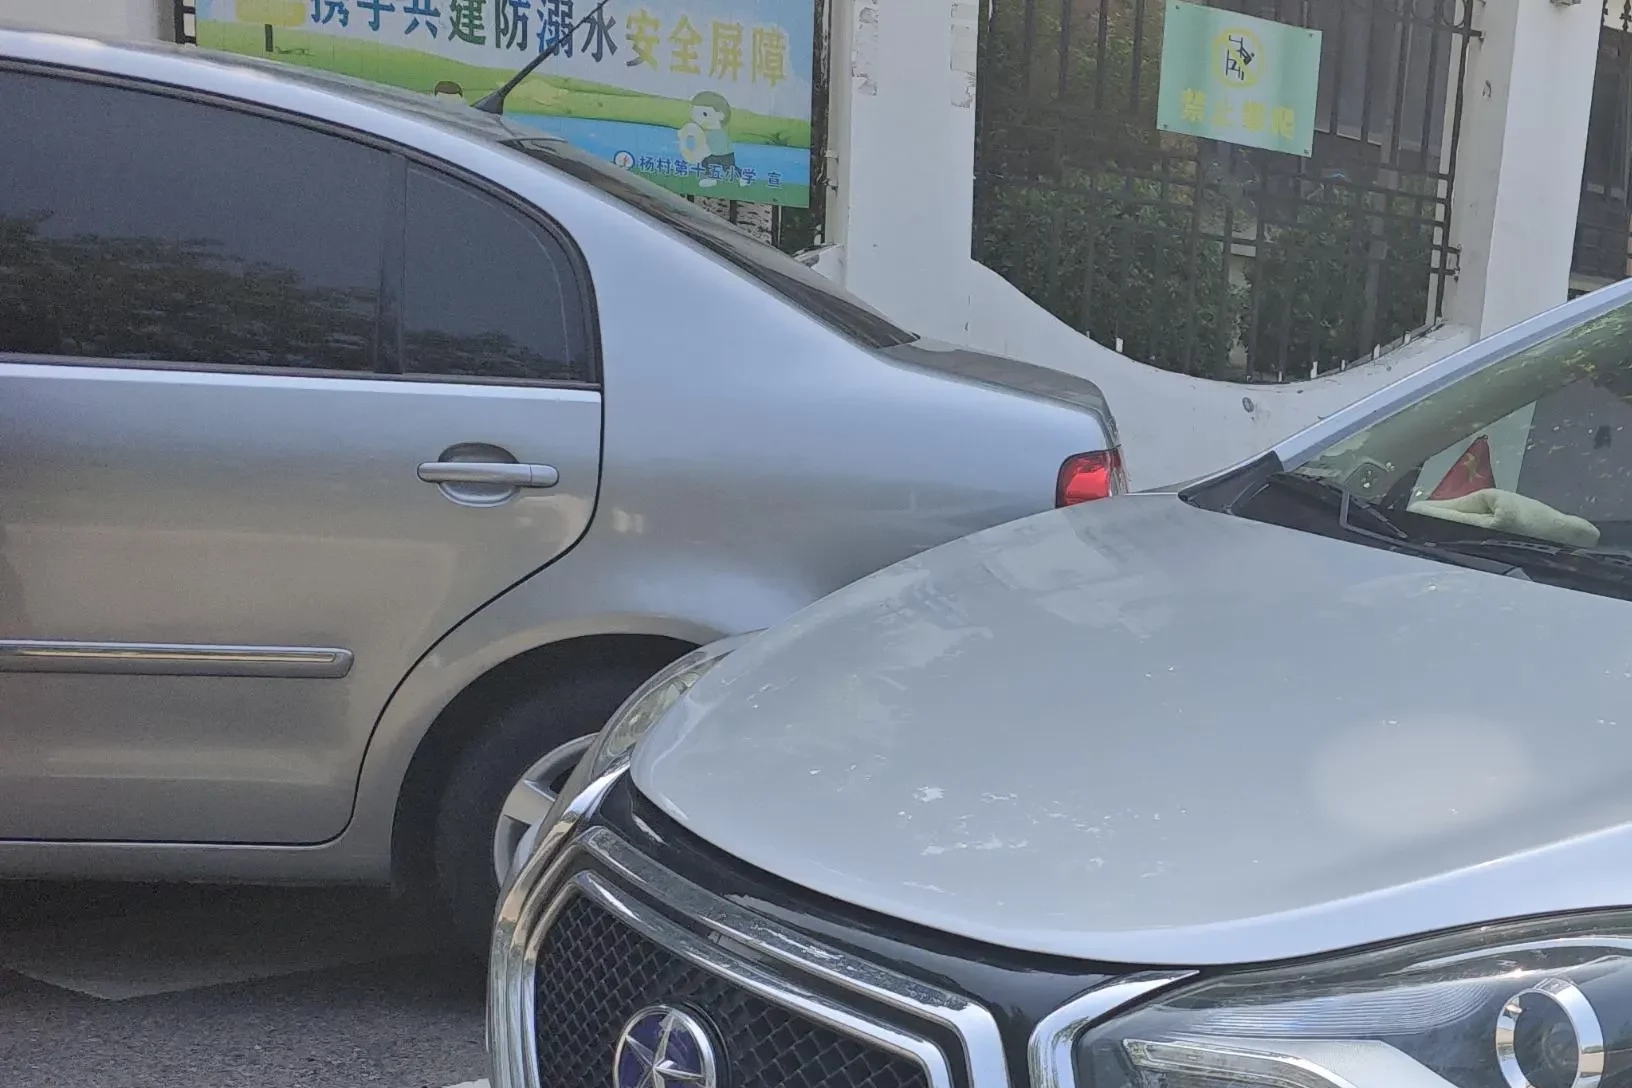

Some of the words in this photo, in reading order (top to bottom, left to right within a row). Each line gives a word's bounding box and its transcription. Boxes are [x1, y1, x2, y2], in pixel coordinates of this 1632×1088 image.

[639, 155, 756, 185] 杨村第十五小学
[767, 171, 782, 187] 宣
